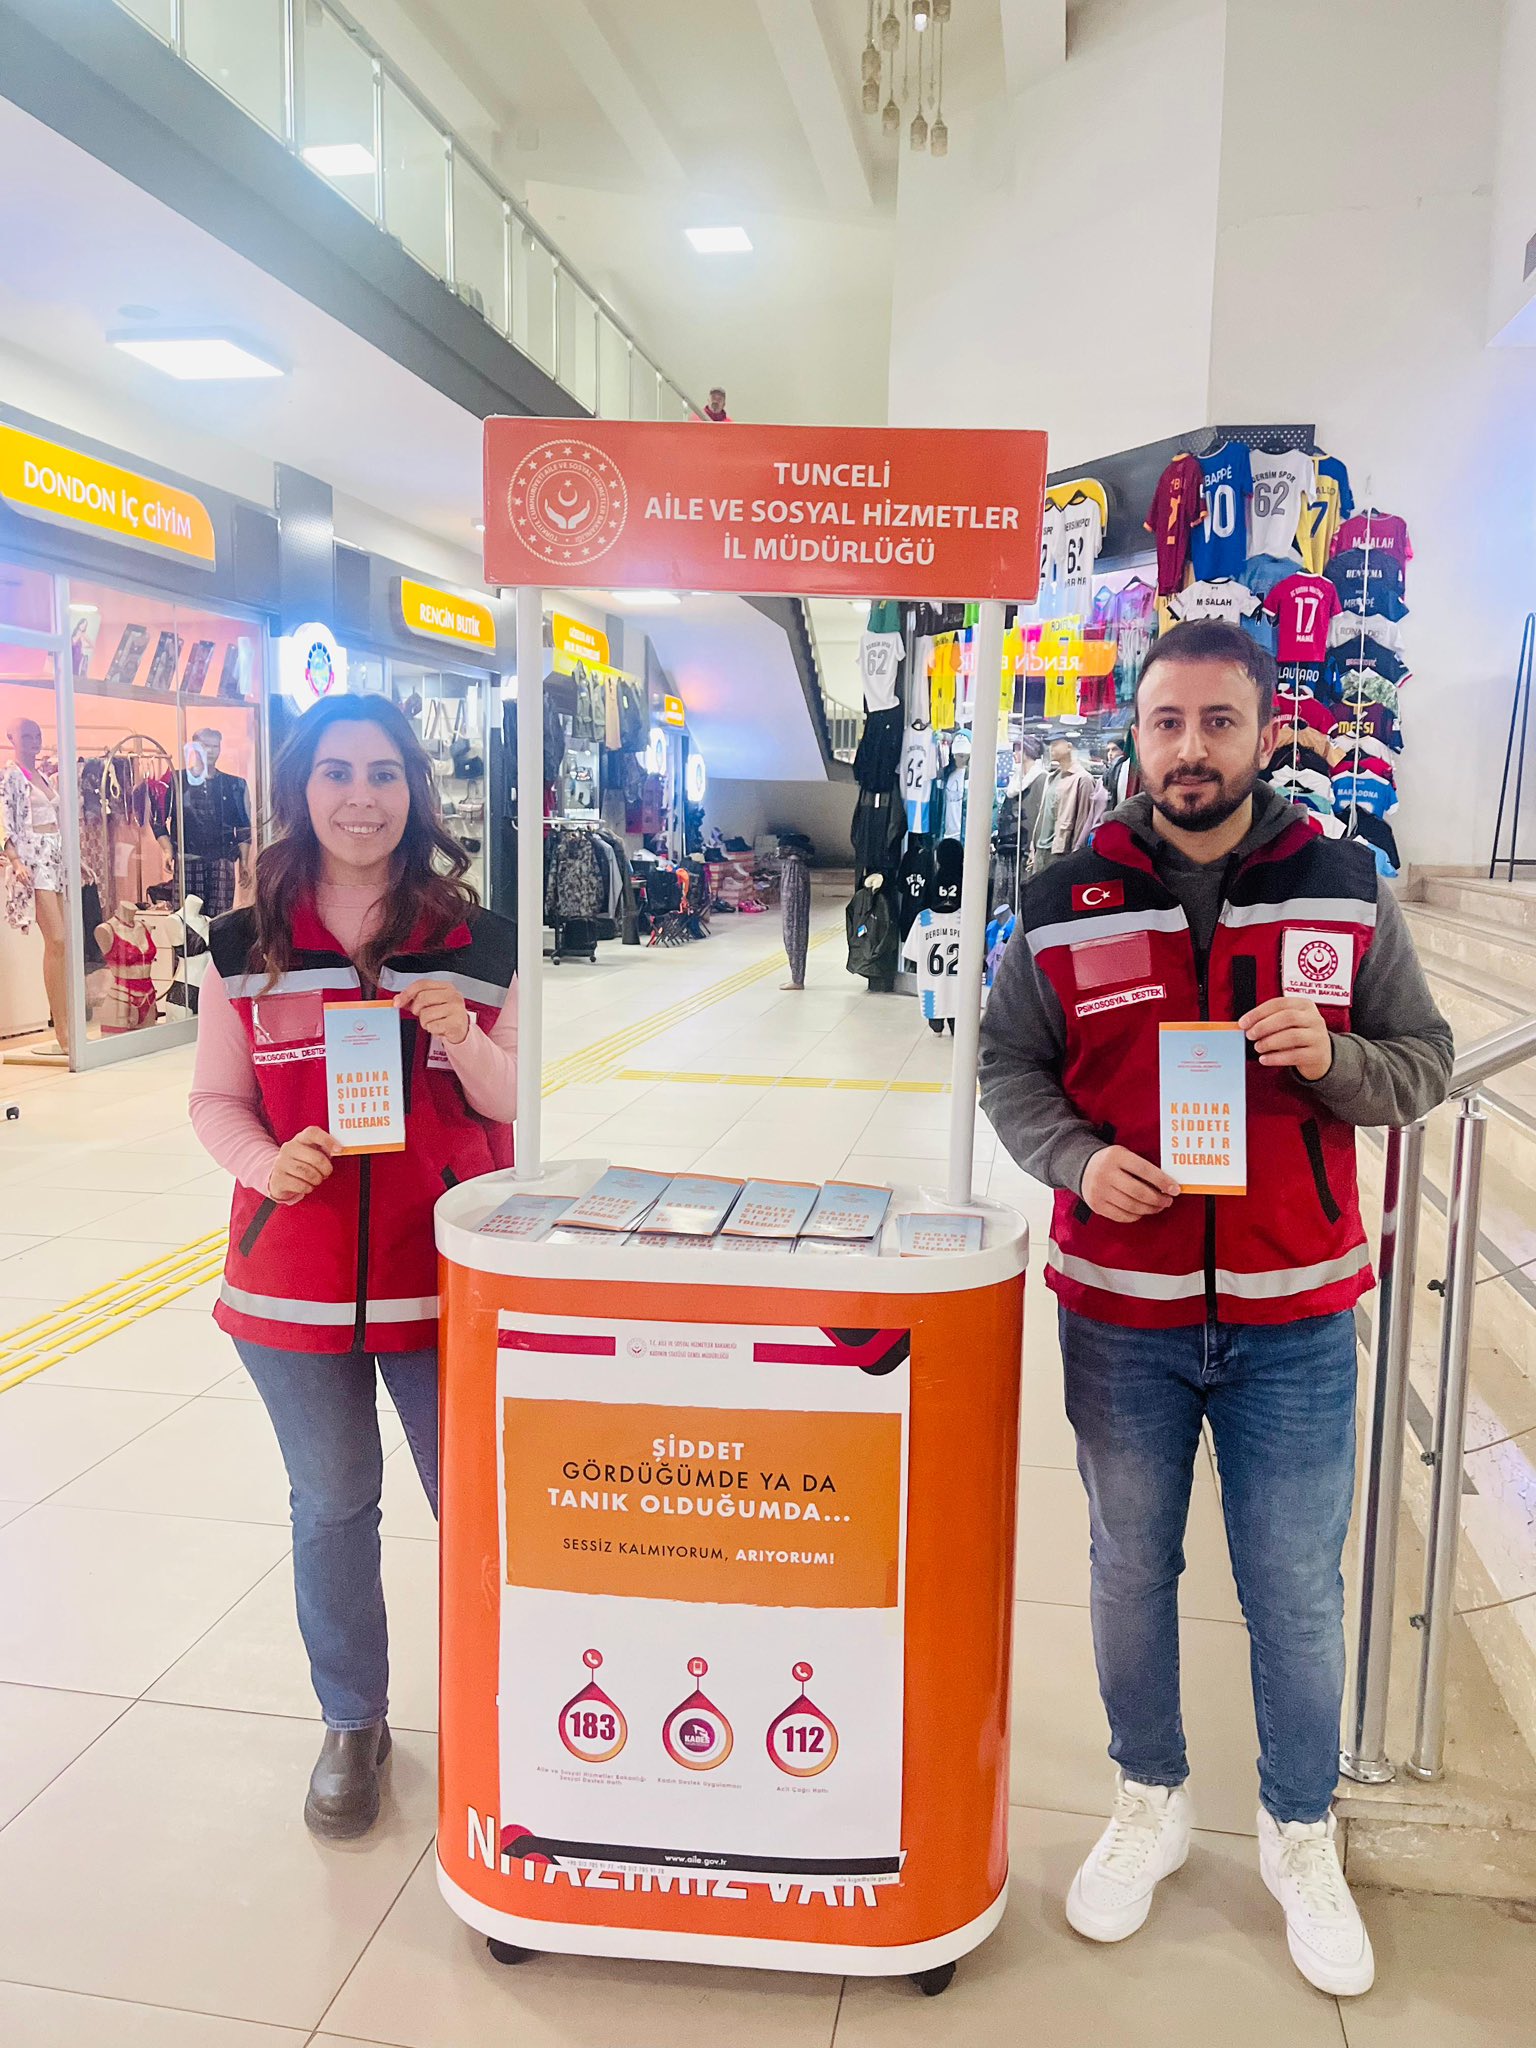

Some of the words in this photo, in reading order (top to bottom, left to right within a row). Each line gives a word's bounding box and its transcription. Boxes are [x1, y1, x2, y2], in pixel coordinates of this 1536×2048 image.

[774, 460, 890, 488] TUNCELİ
[1278, 470, 1296, 483] SPOR
[24, 460, 116, 515] DONDON
[121, 489, 139, 528] İÇ
[143, 501, 192, 539] GİYİM
[644, 491, 704, 521] AİLE
[709, 498, 744, 522] VE
[751, 499, 856, 525] SOSYAL
[863, 498, 1020, 530] HİZMETLER
[1254, 480, 1290, 518] 62
[1307, 500, 1329, 539] 7
[724, 531, 747, 560] İL
[754, 533, 935, 565] MÜDÜRLÜĞÜ
[1366, 536, 1395, 549] ALAH
[1196, 598, 1203, 606] M
[1206, 598, 1232, 606] SALAH
[1295, 596, 1319, 633] 17
[420, 602, 455, 630] RENGİN
[456, 613, 480, 637] BUTİK
[867, 649, 888, 676] 62
[1278, 666, 1320, 683] LAUARO
[938, 884, 958, 897] 62
[927, 942, 960, 977] 62
[1077, 995, 1129, 1015] PSİKOSOSYAL
[1131, 988, 1162, 1001] DESTEK
[336, 1071, 389, 1084] KADINA
[337, 1085, 389, 1101] ŞİDDETE
[338, 1100, 390, 1114] SIFIR
[1170, 1102, 1231, 1115] KADINA
[339, 1115, 391, 1130] TOLERANS
[1171, 1117, 1231, 1133] ŞİDDETE
[1171, 1136, 1231, 1149] SIFIR
[1171, 1152, 1231, 1167] TOLERANS
[652, 1433, 745, 1463] ŞİDDET
[562, 1458, 749, 1489] GÖRDÜĞÜMDE
[760, 1472, 791, 1492] YA
[803, 1474, 837, 1493] DA
[547, 1487, 629, 1512] TANIK
[640, 1493, 850, 1522] OLDUĞUMDA...
[563, 1537, 612, 1553] SESSİZ
[619, 1542, 729, 1562] KALMIYORUM,
[735, 1548, 835, 1565] ARIYORUM!
[569, 1711, 616, 1741] 183
[782, 1725, 825, 1753] 112
[664, 1855, 728, 1867] www.aile.gov.tr
